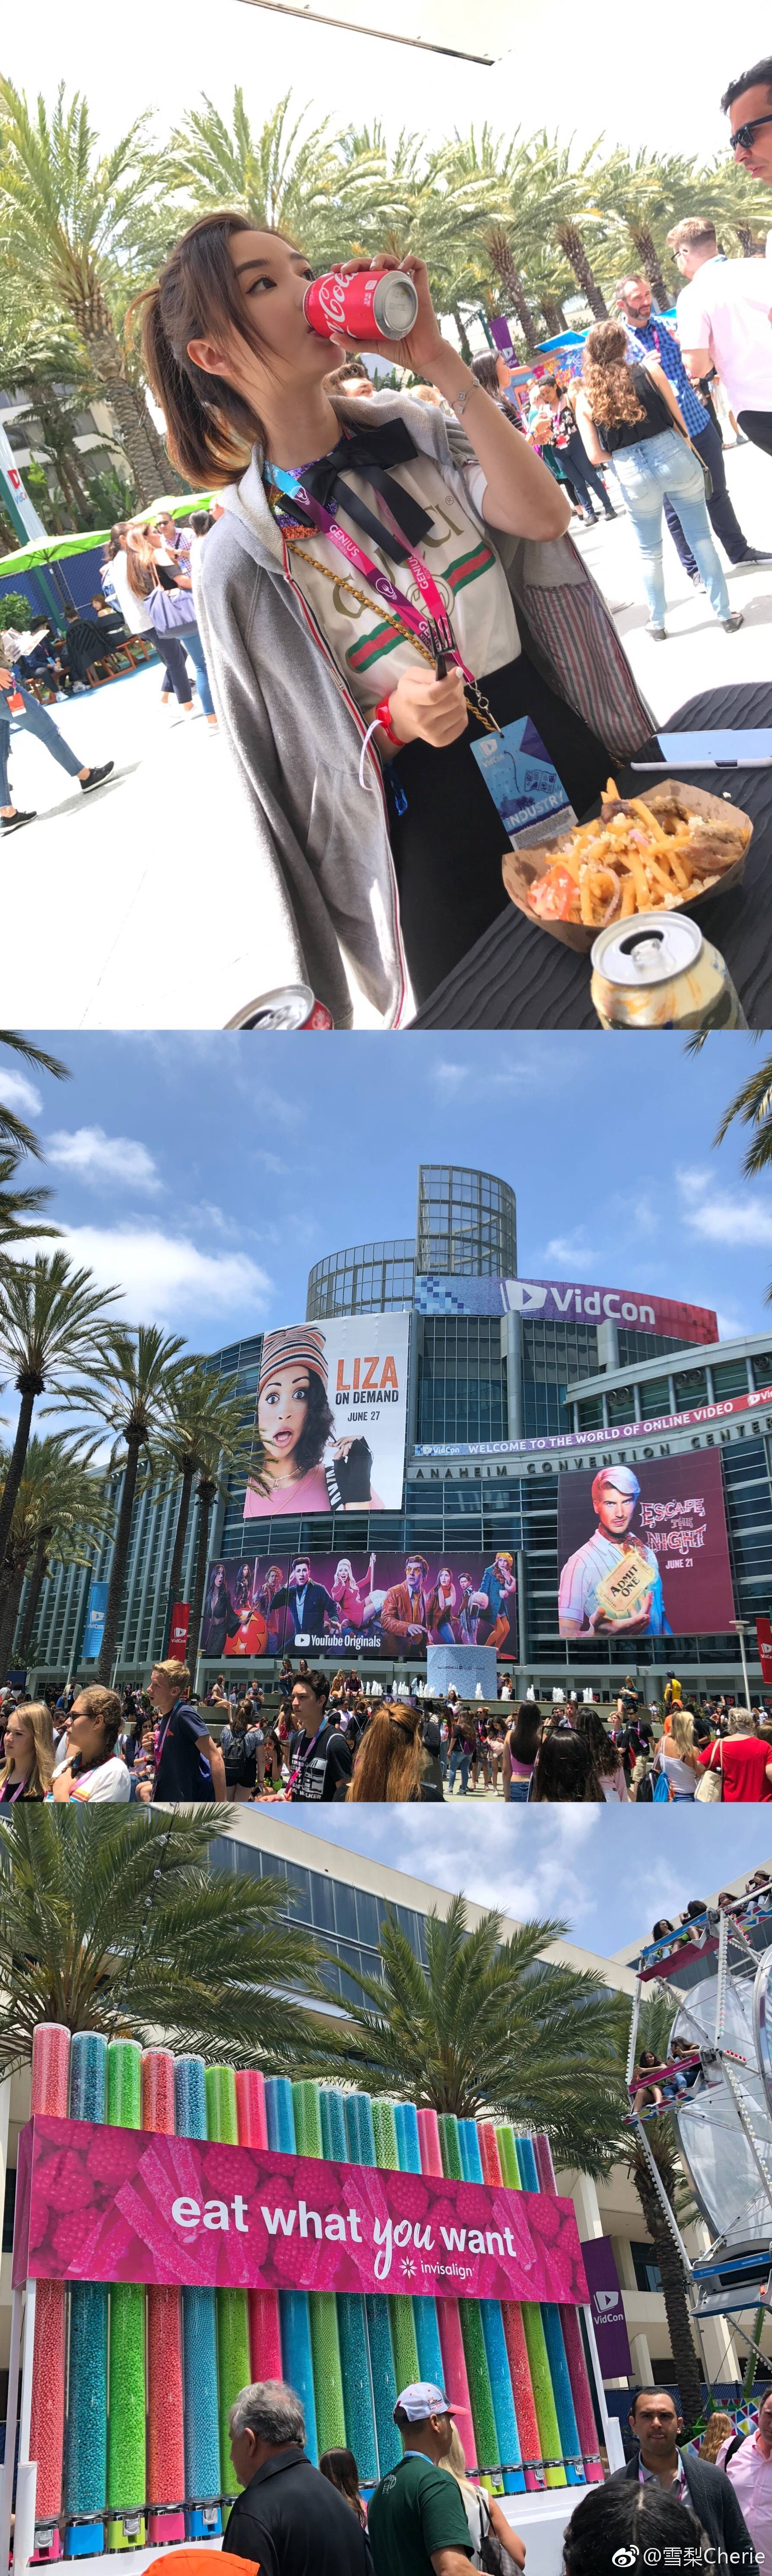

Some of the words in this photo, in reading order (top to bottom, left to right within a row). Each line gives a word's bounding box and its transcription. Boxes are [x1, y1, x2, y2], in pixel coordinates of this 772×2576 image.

[329, 524, 359, 557] GENIUS
[329, 536, 347, 555] KITCHEN
[419, 633, 433, 653] KITCH
[482, 754, 505, 768] VidCon
[506, 791, 564, 828] INDUSTRY
[550, 1287, 656, 1325] VidCon
[336, 1356, 399, 1391] LIZA
[335, 1392, 349, 1405] ON
[353, 1390, 399, 1404] DEMAND
[347, 1412, 368, 1422] JUNE
[371, 1411, 380, 1421] 27
[469, 1443, 526, 1454] WELCOME
[530, 1440, 546, 1449] TO
[549, 1436, 572, 1447] THE
[576, 1429, 620, 1444] WORLD
[623, 1425, 640, 1436] OF
[644, 1414, 690, 1432] ONLINE
[694, 1402, 734, 1420] VIDEO
[416, 1465, 507, 1478] ANAHEIM
[527, 1444, 670, 1473] CONVENTION
[691, 1417, 772, 1448] CENTER
[639, 1498, 706, 1528] ESCAPE
[671, 1517, 693, 1530] THE
[645, 1524, 707, 1555] NIGHT
[665, 1559, 684, 1569] JUNE
[685, 1558, 693, 1567] 21
[610, 1564, 639, 1597] ADMIT
[621, 1577, 641, 1597] ONE
[311, 1635, 343, 1647] YouTube
[344, 1635, 381, 1650] Originals
[172, 2195, 248, 2232] eat
[261, 2200, 362, 2243] what
[373, 2217, 435, 2280] you
[440, 2227, 517, 2257] want
[421, 2260, 473, 2280] invisalign
[594, 2314, 624, 2325] VidCon
